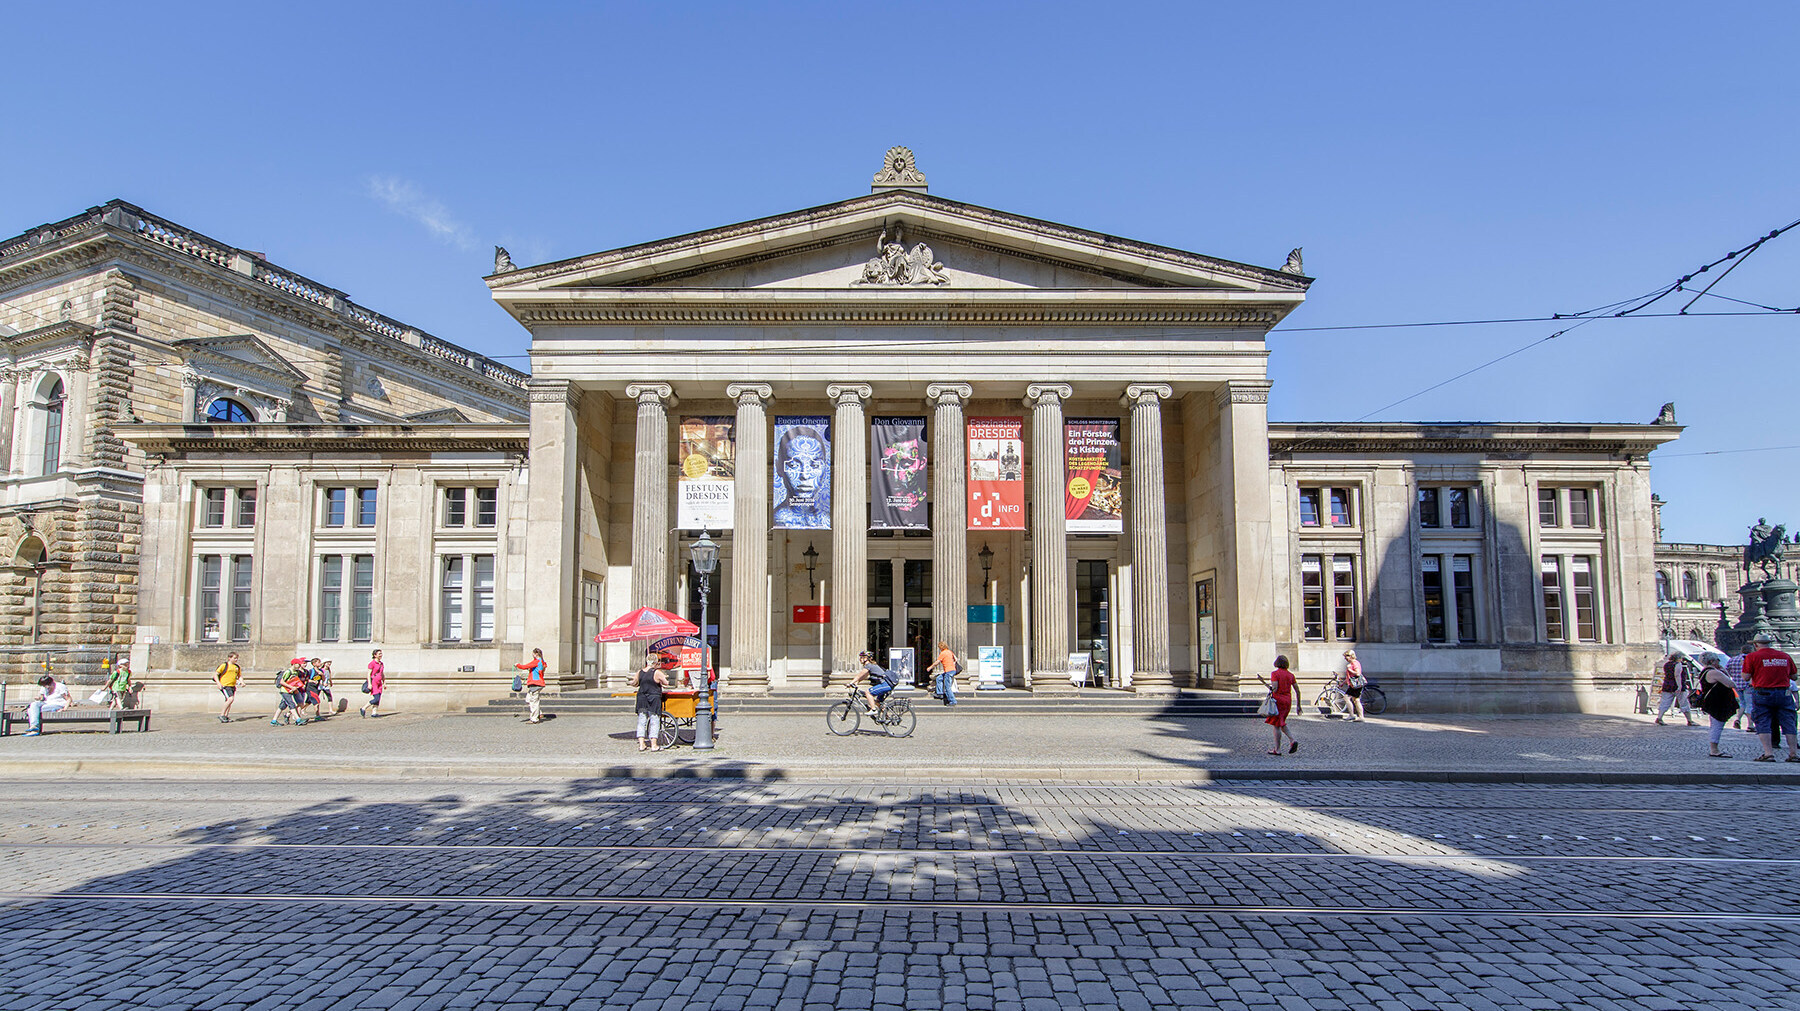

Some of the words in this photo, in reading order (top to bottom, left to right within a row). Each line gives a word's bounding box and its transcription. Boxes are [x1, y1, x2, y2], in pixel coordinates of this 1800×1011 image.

[777, 417, 800, 425] Eugen
[802, 417, 828, 425] Onegin
[874, 417, 890, 425] Don
[891, 417, 925, 425] Giovanni
[970, 419, 1021, 428] Faszination
[970, 428, 1021, 439] DRESDEN
[1068, 430, 1081, 438] Ein
[1082, 430, 1113, 439] Förster,
[1068, 438, 1085, 446] drei
[1086, 438, 1118, 447] Prinzen,
[1068, 447, 1078, 455] 43
[1079, 446, 1107, 454] Kisten.
[686, 484, 729, 492] FESTUNG
[686, 492, 729, 500] DRESDEN
[981, 500, 992, 518] d
[998, 504, 1020, 513] INFO
